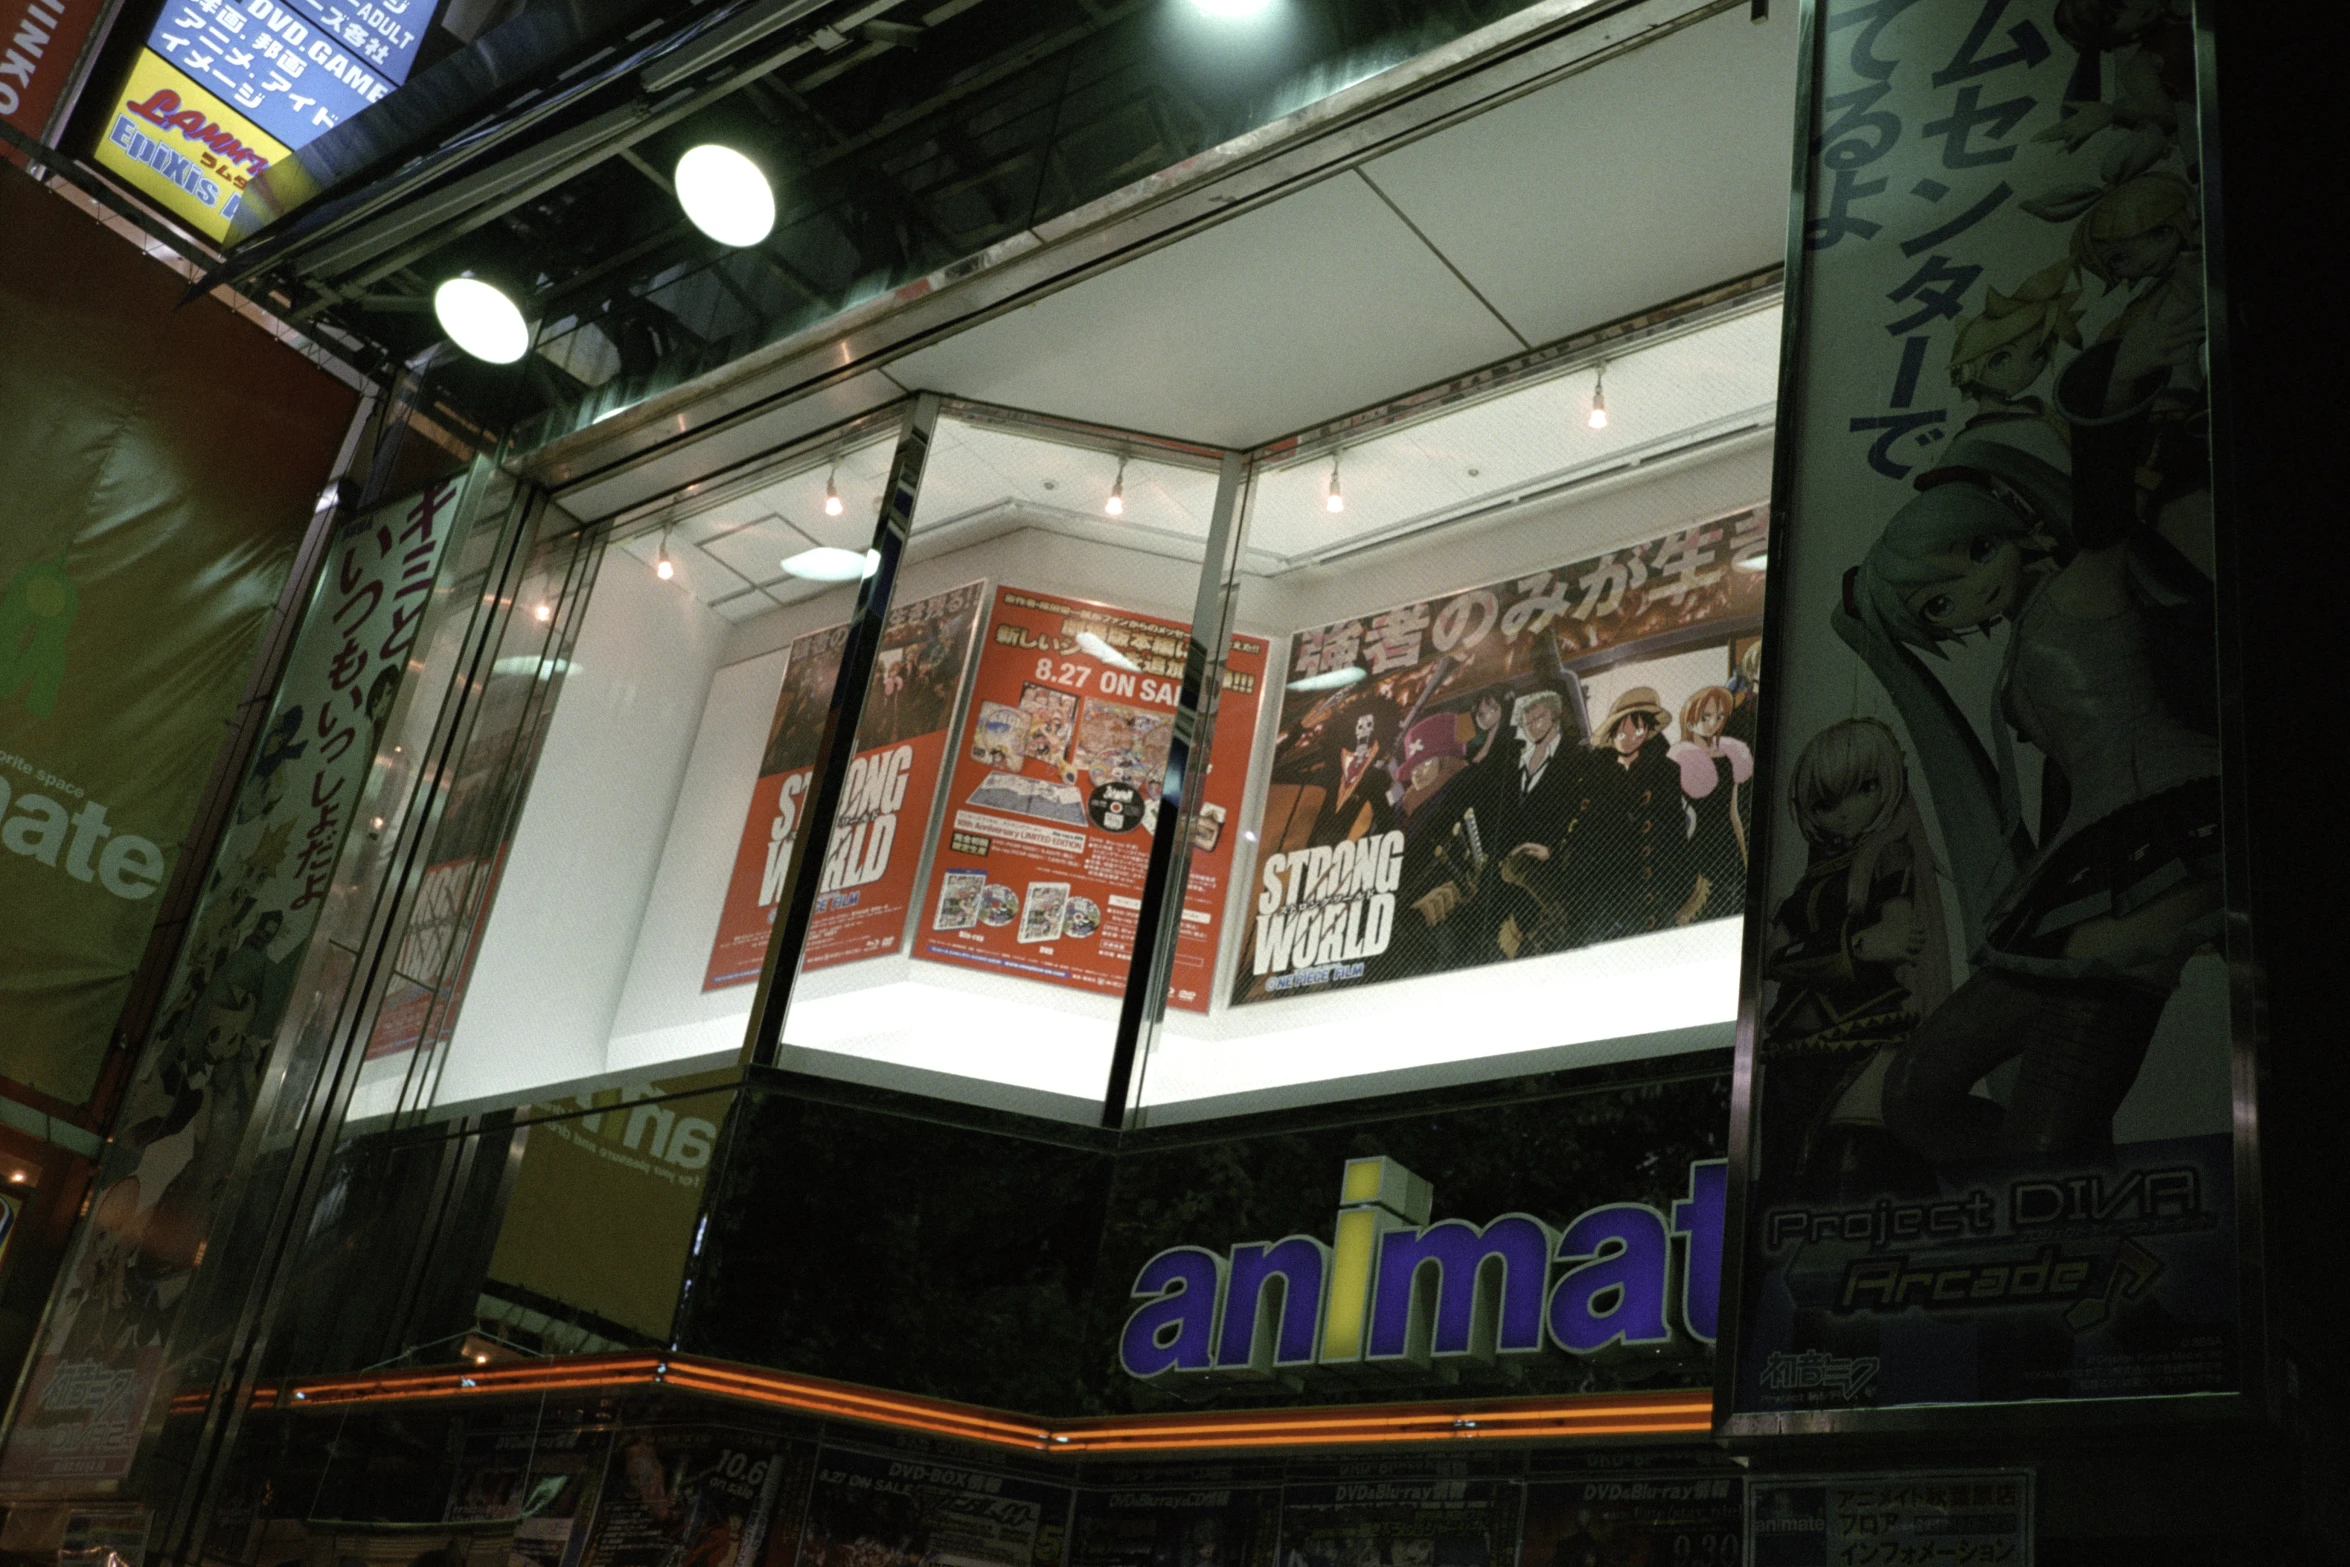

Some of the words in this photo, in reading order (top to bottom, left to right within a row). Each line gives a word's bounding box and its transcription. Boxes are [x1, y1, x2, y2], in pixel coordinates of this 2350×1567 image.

[162, 33, 265, 108] イメージ
[380, 484, 457, 662] キミと
[1035, 657, 1092, 690] 8.27
[1099, 670, 1137, 698] ON
[36, 768, 86, 799] space
[758, 812, 897, 909] WRLD
[1258, 829, 1405, 915] STRONG
[1253, 892, 1396, 976] WORLD
[1265, 975, 1293, 993] ONE
[1293, 967, 1330, 987] PIECE
[1333, 961, 1365, 982] FILM
[2014, 1170, 2197, 1225] DIVA
[1842, 1246, 2090, 1306] Arcade
[1759, 1348, 1881, 1400] 初音ミク
[716, 1448, 769, 1486] 10.6
[873, 1478, 914, 1497] SALE
[1755, 1515, 1826, 1533] animate
[1837, 1511, 1899, 1536] フロア
[1837, 1539, 2017, 1567] インフォメーション
